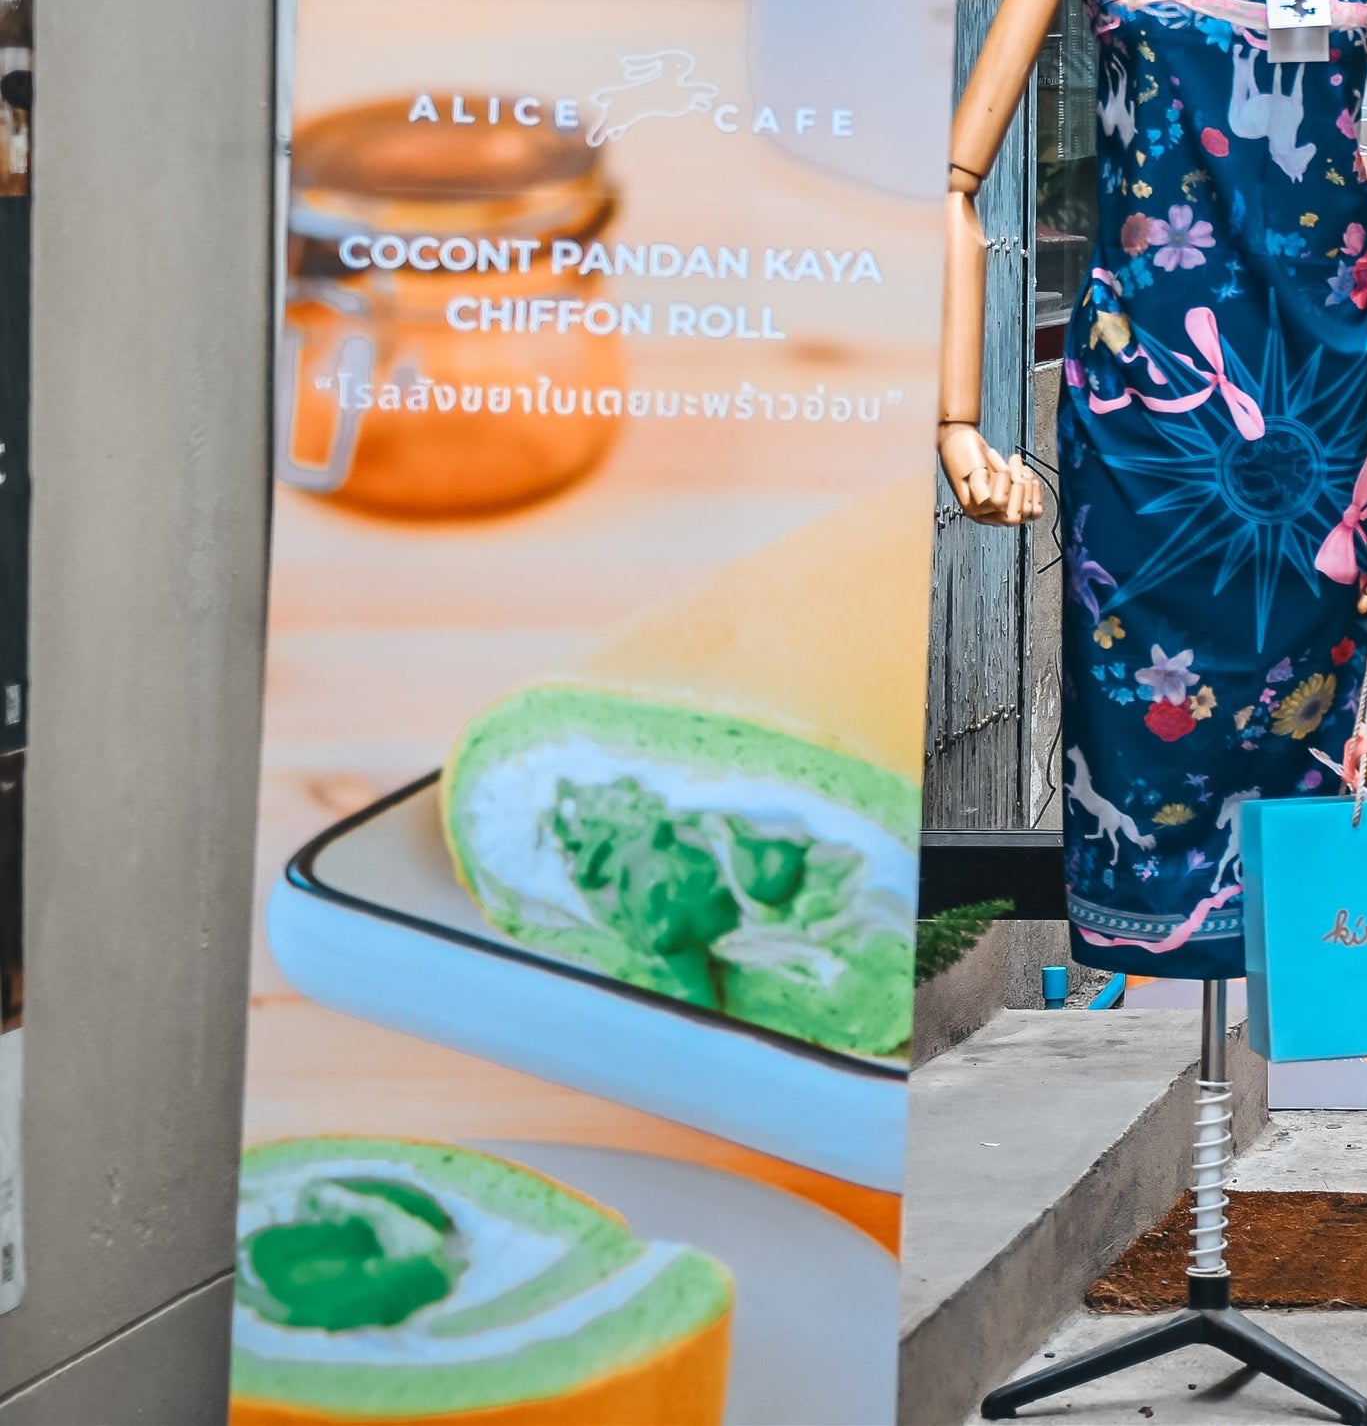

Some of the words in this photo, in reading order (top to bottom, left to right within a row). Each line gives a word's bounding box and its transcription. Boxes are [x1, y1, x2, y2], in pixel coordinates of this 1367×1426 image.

[408, 93, 580, 128] ALICE
[711, 103, 855, 137] CAFE
[338, 235, 542, 274] COCONT
[550, 238, 752, 280] PANDAN
[764, 248, 883, 286] KAYA
[446, 296, 654, 338] CHIFFON
[667, 301, 787, 341] ROLL
